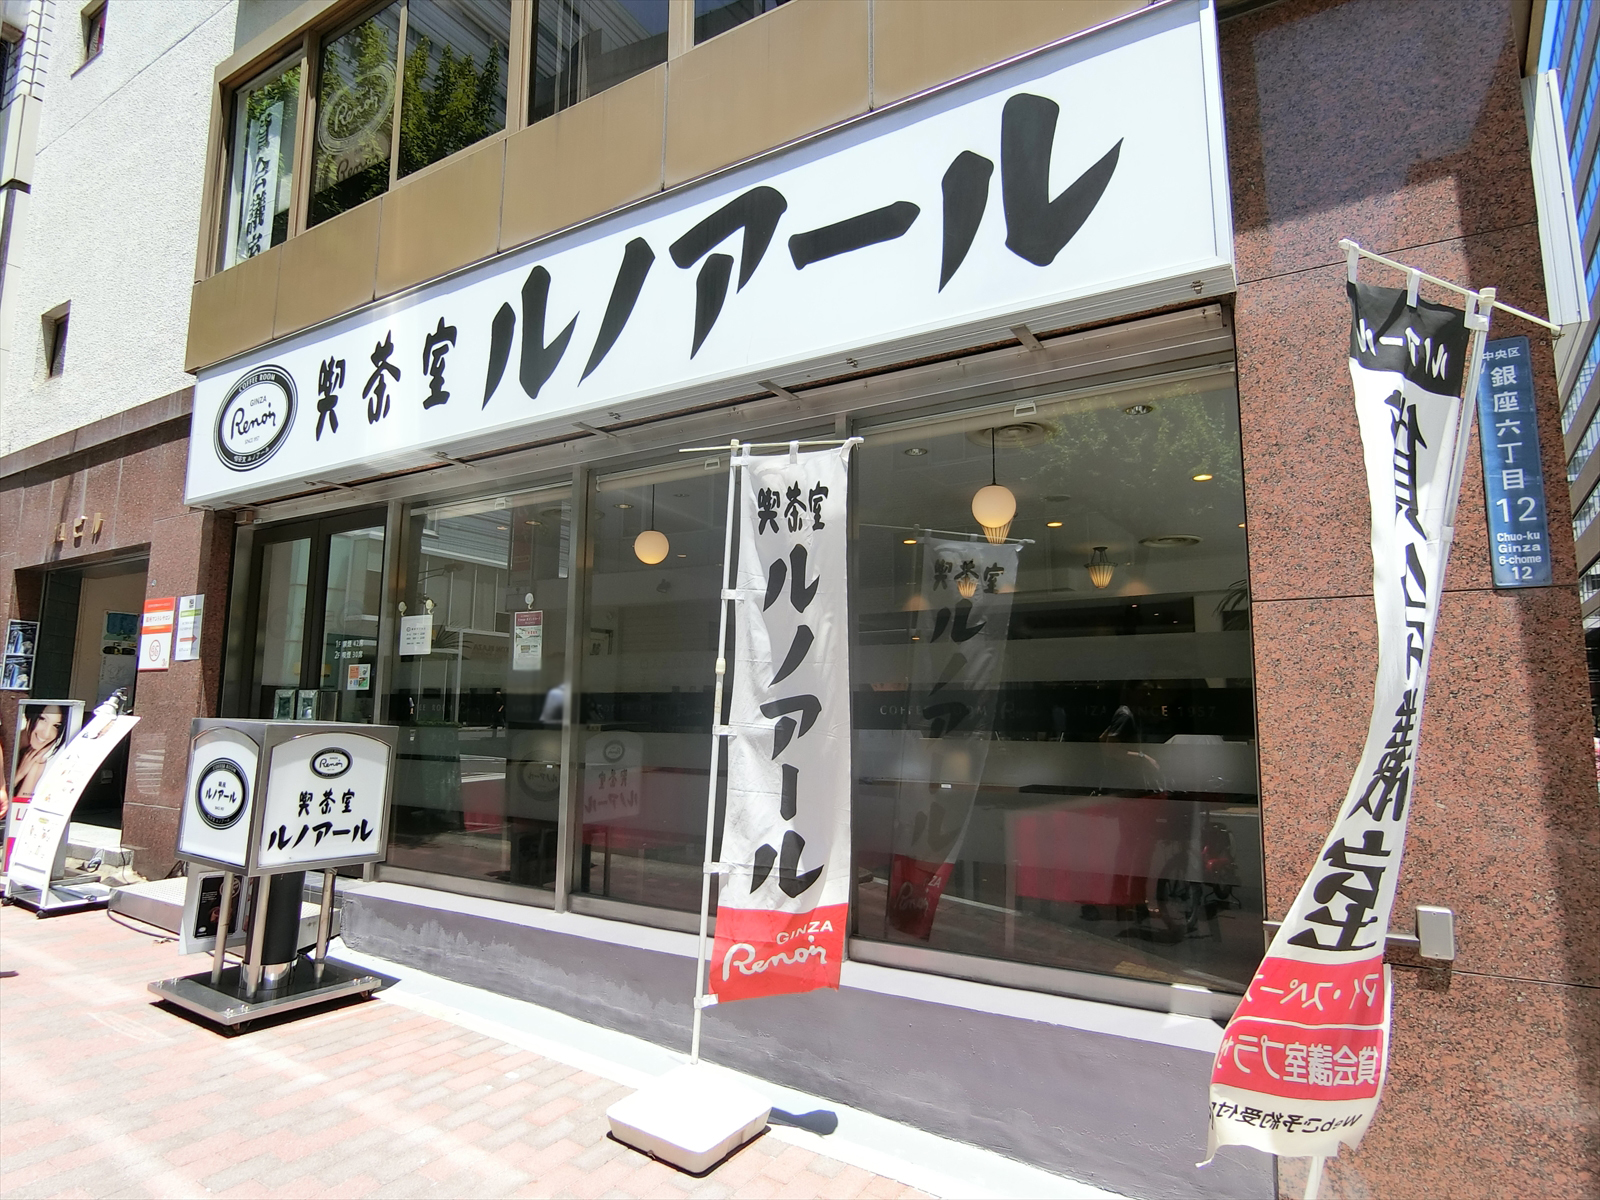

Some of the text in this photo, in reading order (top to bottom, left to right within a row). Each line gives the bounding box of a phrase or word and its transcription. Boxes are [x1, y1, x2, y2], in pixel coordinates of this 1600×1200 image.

[315, 92, 1124, 442] 喫茶室 ルノアール
[1482, 347, 1521, 361] 中央区
[238, 373, 276, 392] COFFEE ROOM
[249, 395, 267, 407] GINZA
[230, 402, 277, 440] Renoir
[1490, 364, 1525, 491] 銀座六丁目
[757, 480, 829, 536] 喫茶室
[1496, 496, 1538, 523] 12
[1496, 531, 1541, 543] Chuo-ku
[1498, 543, 1541, 554] Ginza
[1499, 554, 1542, 566] 6-chome
[1511, 566, 1534, 580] 12
[750, 543, 825, 898] ルノアール
[879, 705, 925, 716] COFFE
[319, 758, 343, 768] Renoir
[205, 787, 237, 803] ルノアール
[298, 788, 356, 818] 喫茶室
[267, 818, 374, 852] ルノアール
[776, 920, 834, 945] GINZA
[722, 934, 828, 982] Renoir
